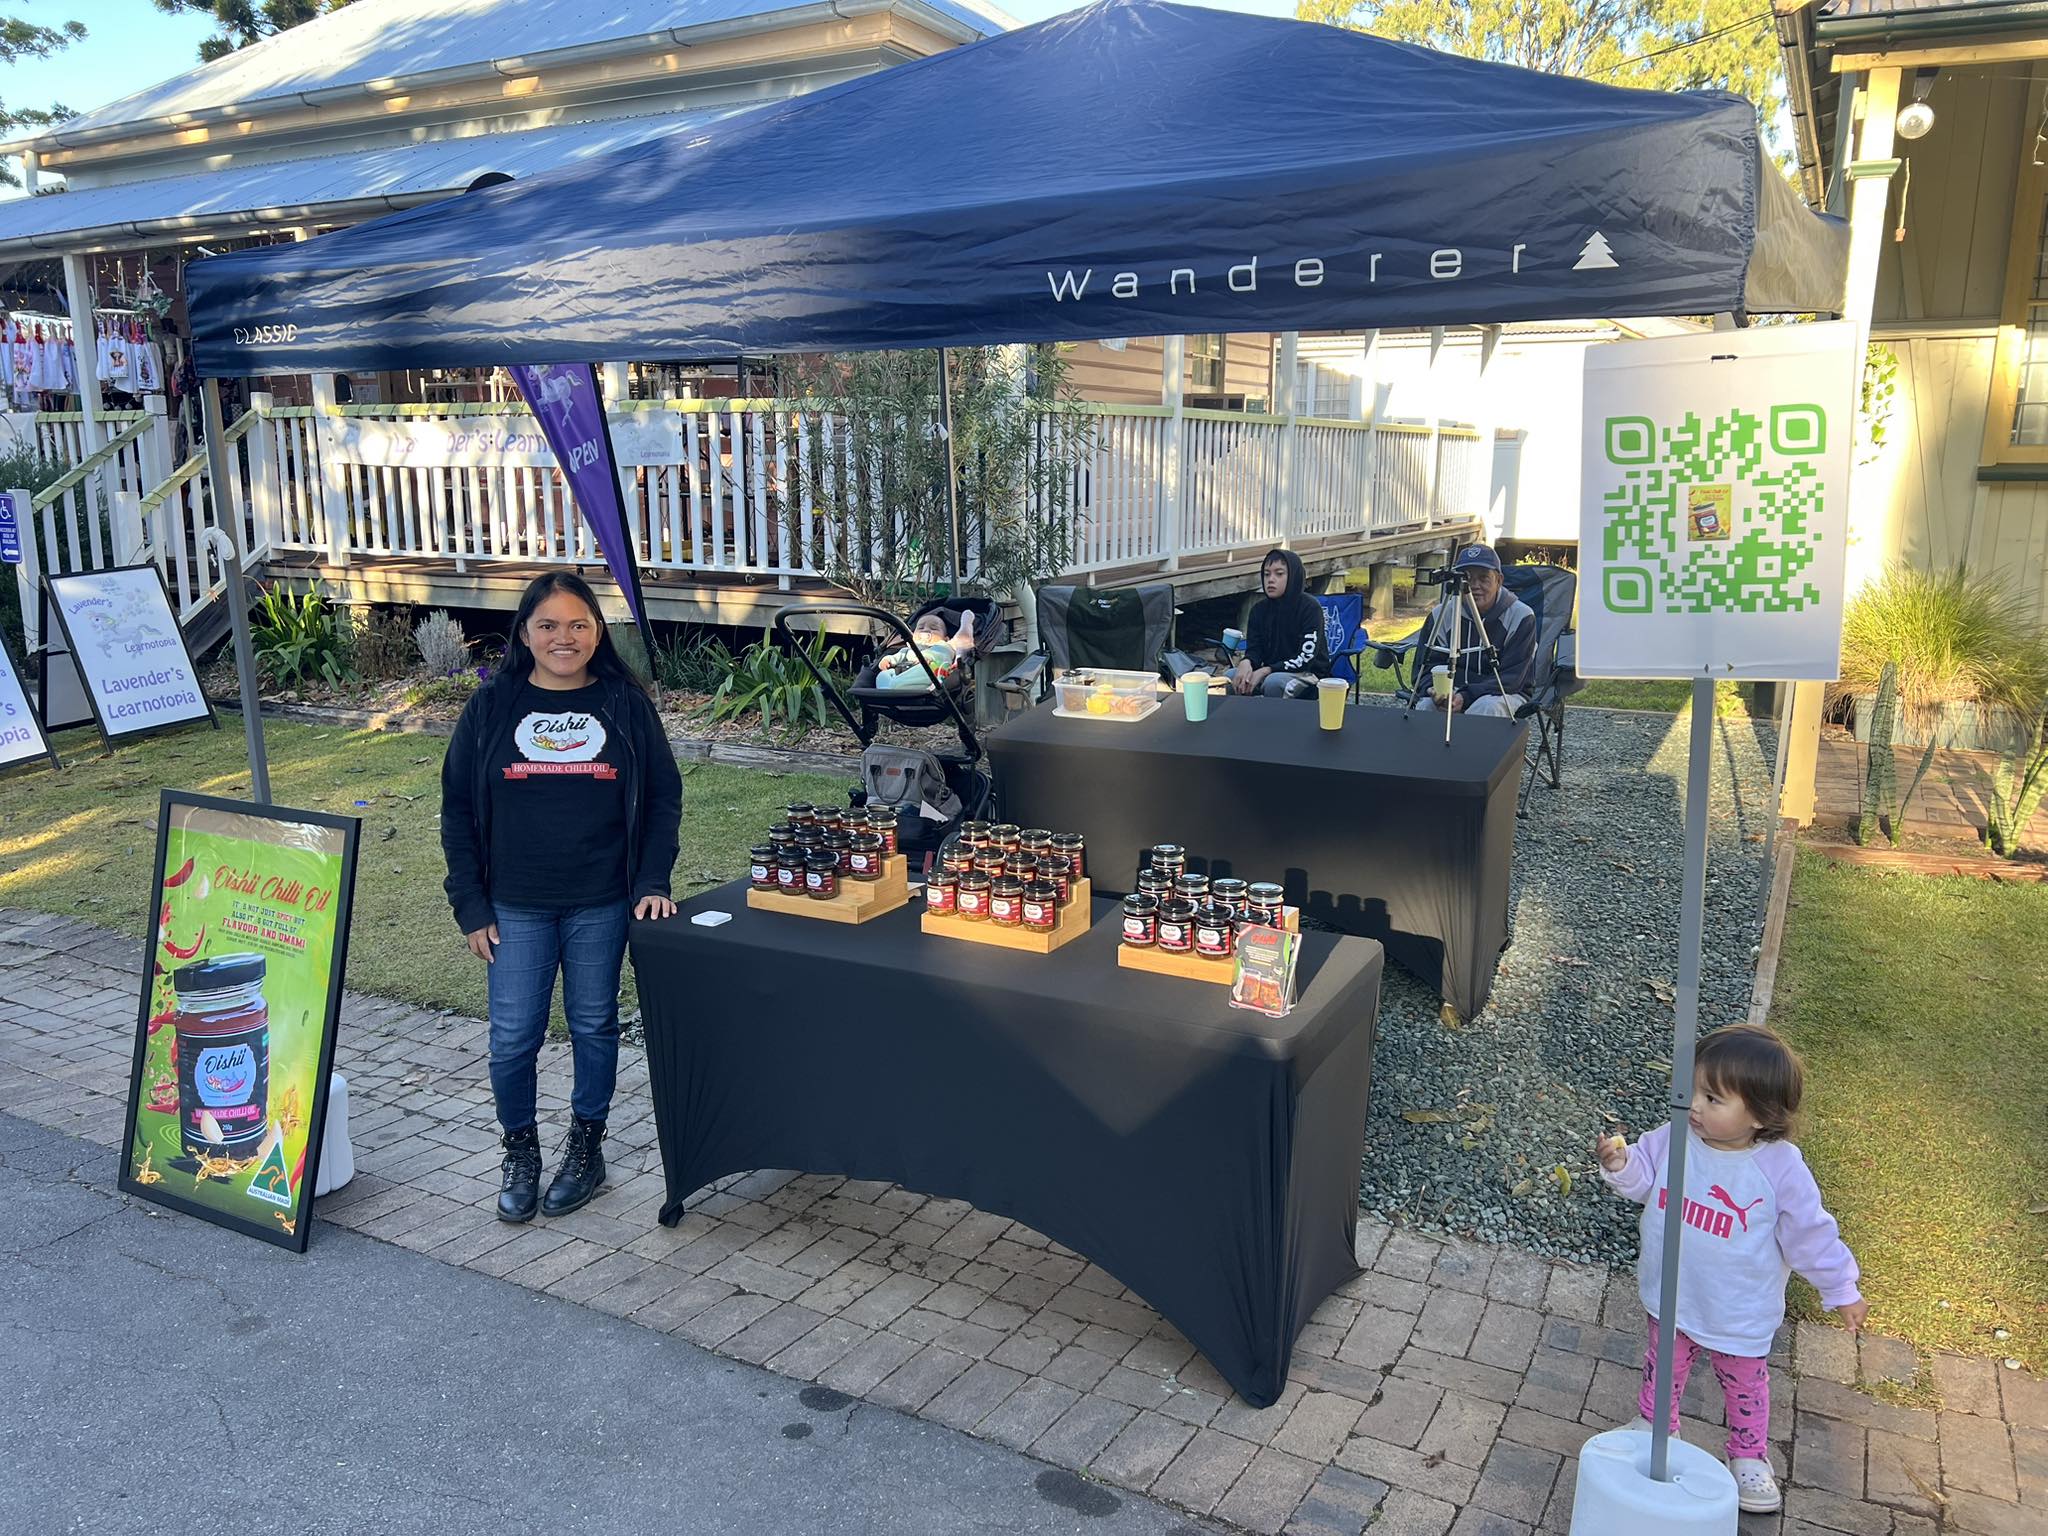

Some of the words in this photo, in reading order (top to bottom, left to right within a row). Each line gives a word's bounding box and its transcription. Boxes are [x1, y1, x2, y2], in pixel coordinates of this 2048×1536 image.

[233, 323, 298, 345] CLASSIC
[568, 438, 600, 474] OPEN
[68, 597, 113, 615] Lavender's
[124, 636, 177, 654] Learnotopia
[101, 667, 185, 695] Lavender's
[107, 690, 197, 719] Learnotopia
[532, 715, 589, 734] Oishii
[513, 763, 564, 773] HOMEMADE
[564, 763, 592, 773] CHILLI
[593, 763, 609, 773] OIL
[214, 865, 261, 894] Oishii
[260, 876, 304, 905] Chilli
[303, 886, 332, 912] Oil
[231, 911, 246, 920] ALSO
[262, 917, 273, 927] GOT
[274, 921, 289, 932] FULL
[247, 903, 259, 913] NOT
[260, 907, 276, 917] JUST
[276, 912, 294, 922] SPICY
[222, 917, 259, 935] FLAVOUR
[261, 927, 277, 940] AND
[279, 932, 306, 949] UMAMI
[204, 1048, 247, 1074] Oishii
[228, 1106, 247, 1118] CHILLI
[248, 1187, 277, 1201] AUSTRALIAN
[276, 1195, 290, 1206] MADE
